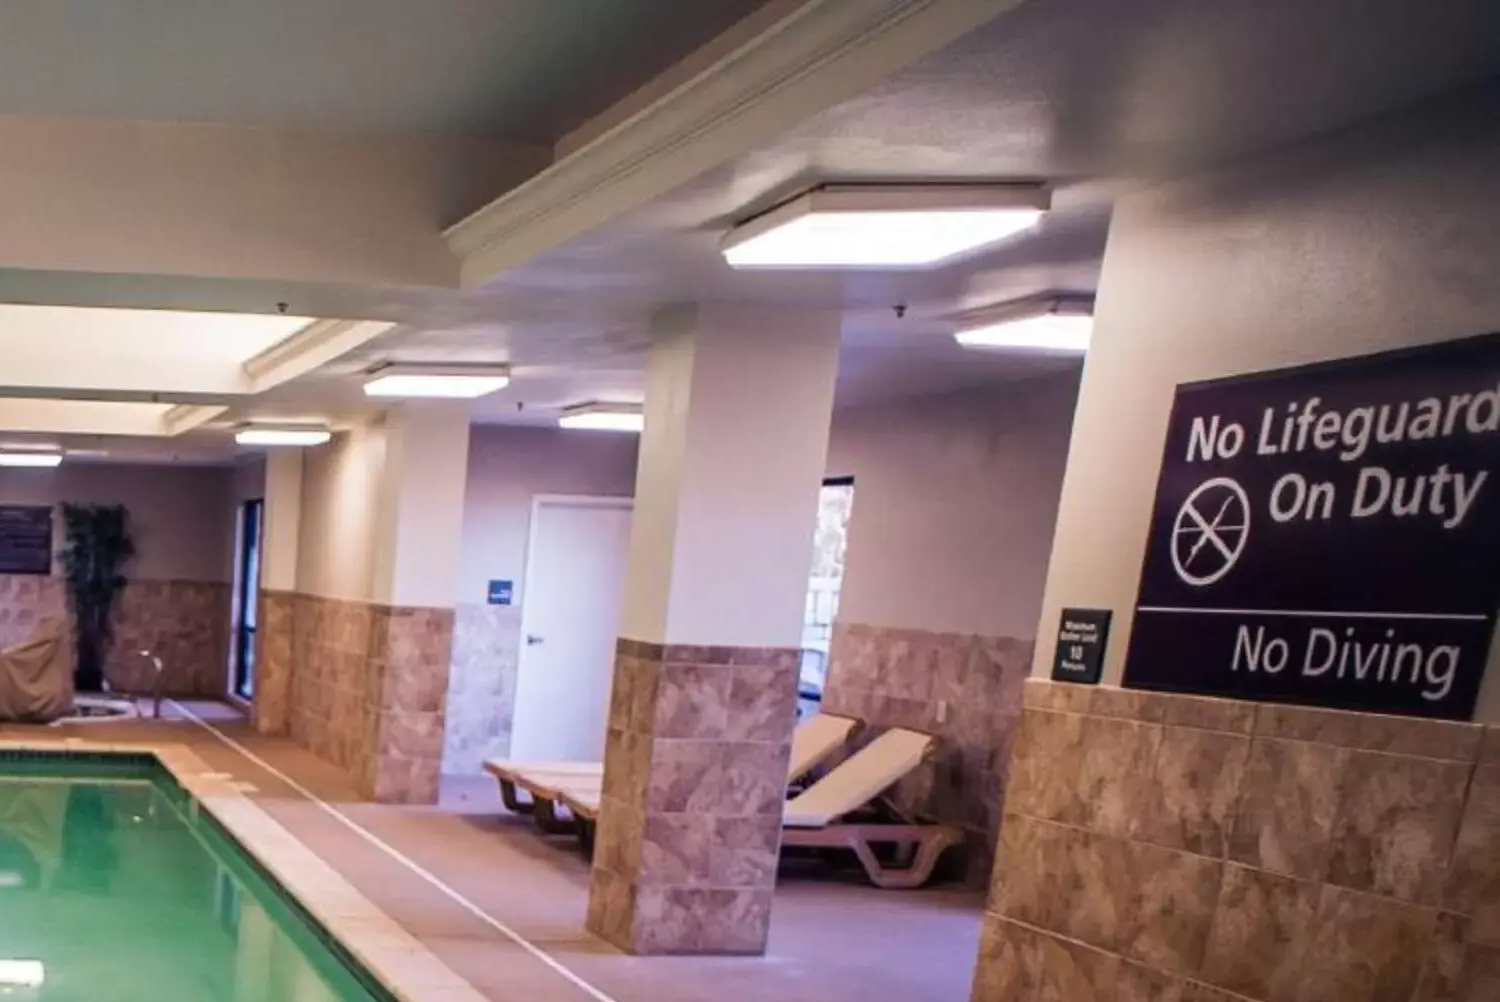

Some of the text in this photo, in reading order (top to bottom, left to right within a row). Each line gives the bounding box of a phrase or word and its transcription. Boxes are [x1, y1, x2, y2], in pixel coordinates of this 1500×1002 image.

[1185, 380, 1500, 462] No Lifeguard
[1269, 463, 1489, 528] On Duty
[1230, 624, 1461, 700] No Diving
